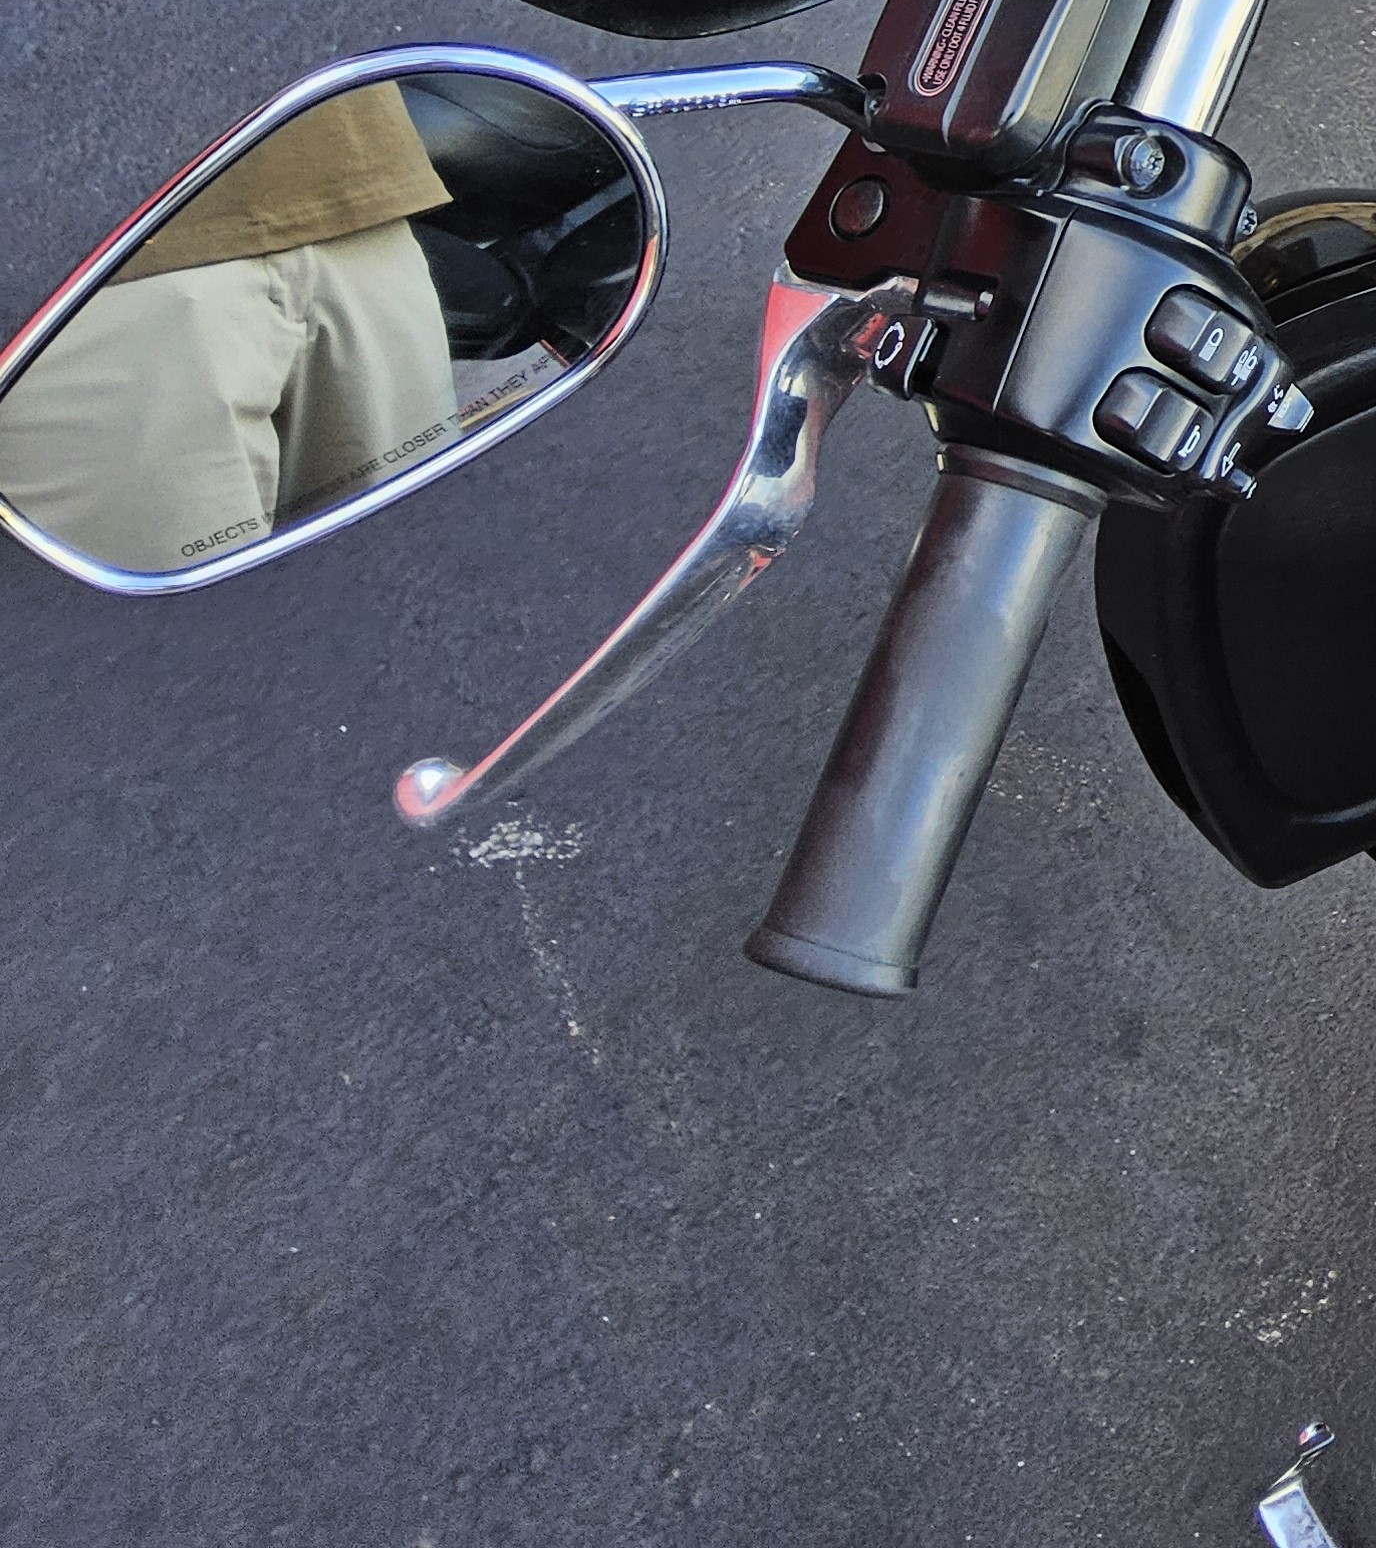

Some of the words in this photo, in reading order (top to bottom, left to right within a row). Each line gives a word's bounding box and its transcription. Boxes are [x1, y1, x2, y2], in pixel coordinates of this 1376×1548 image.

[940, 50, 955, 68] ONLY
[950, 31, 963, 48] DOT
[961, 4, 976, 26] FLUID
[942, 12, 960, 37] CLEAN
[181, 517, 260, 558] OBJECTS
[350, 458, 381, 480] ARE
[383, 423, 447, 464] CLOSER
[489, 369, 529, 398] THEY
